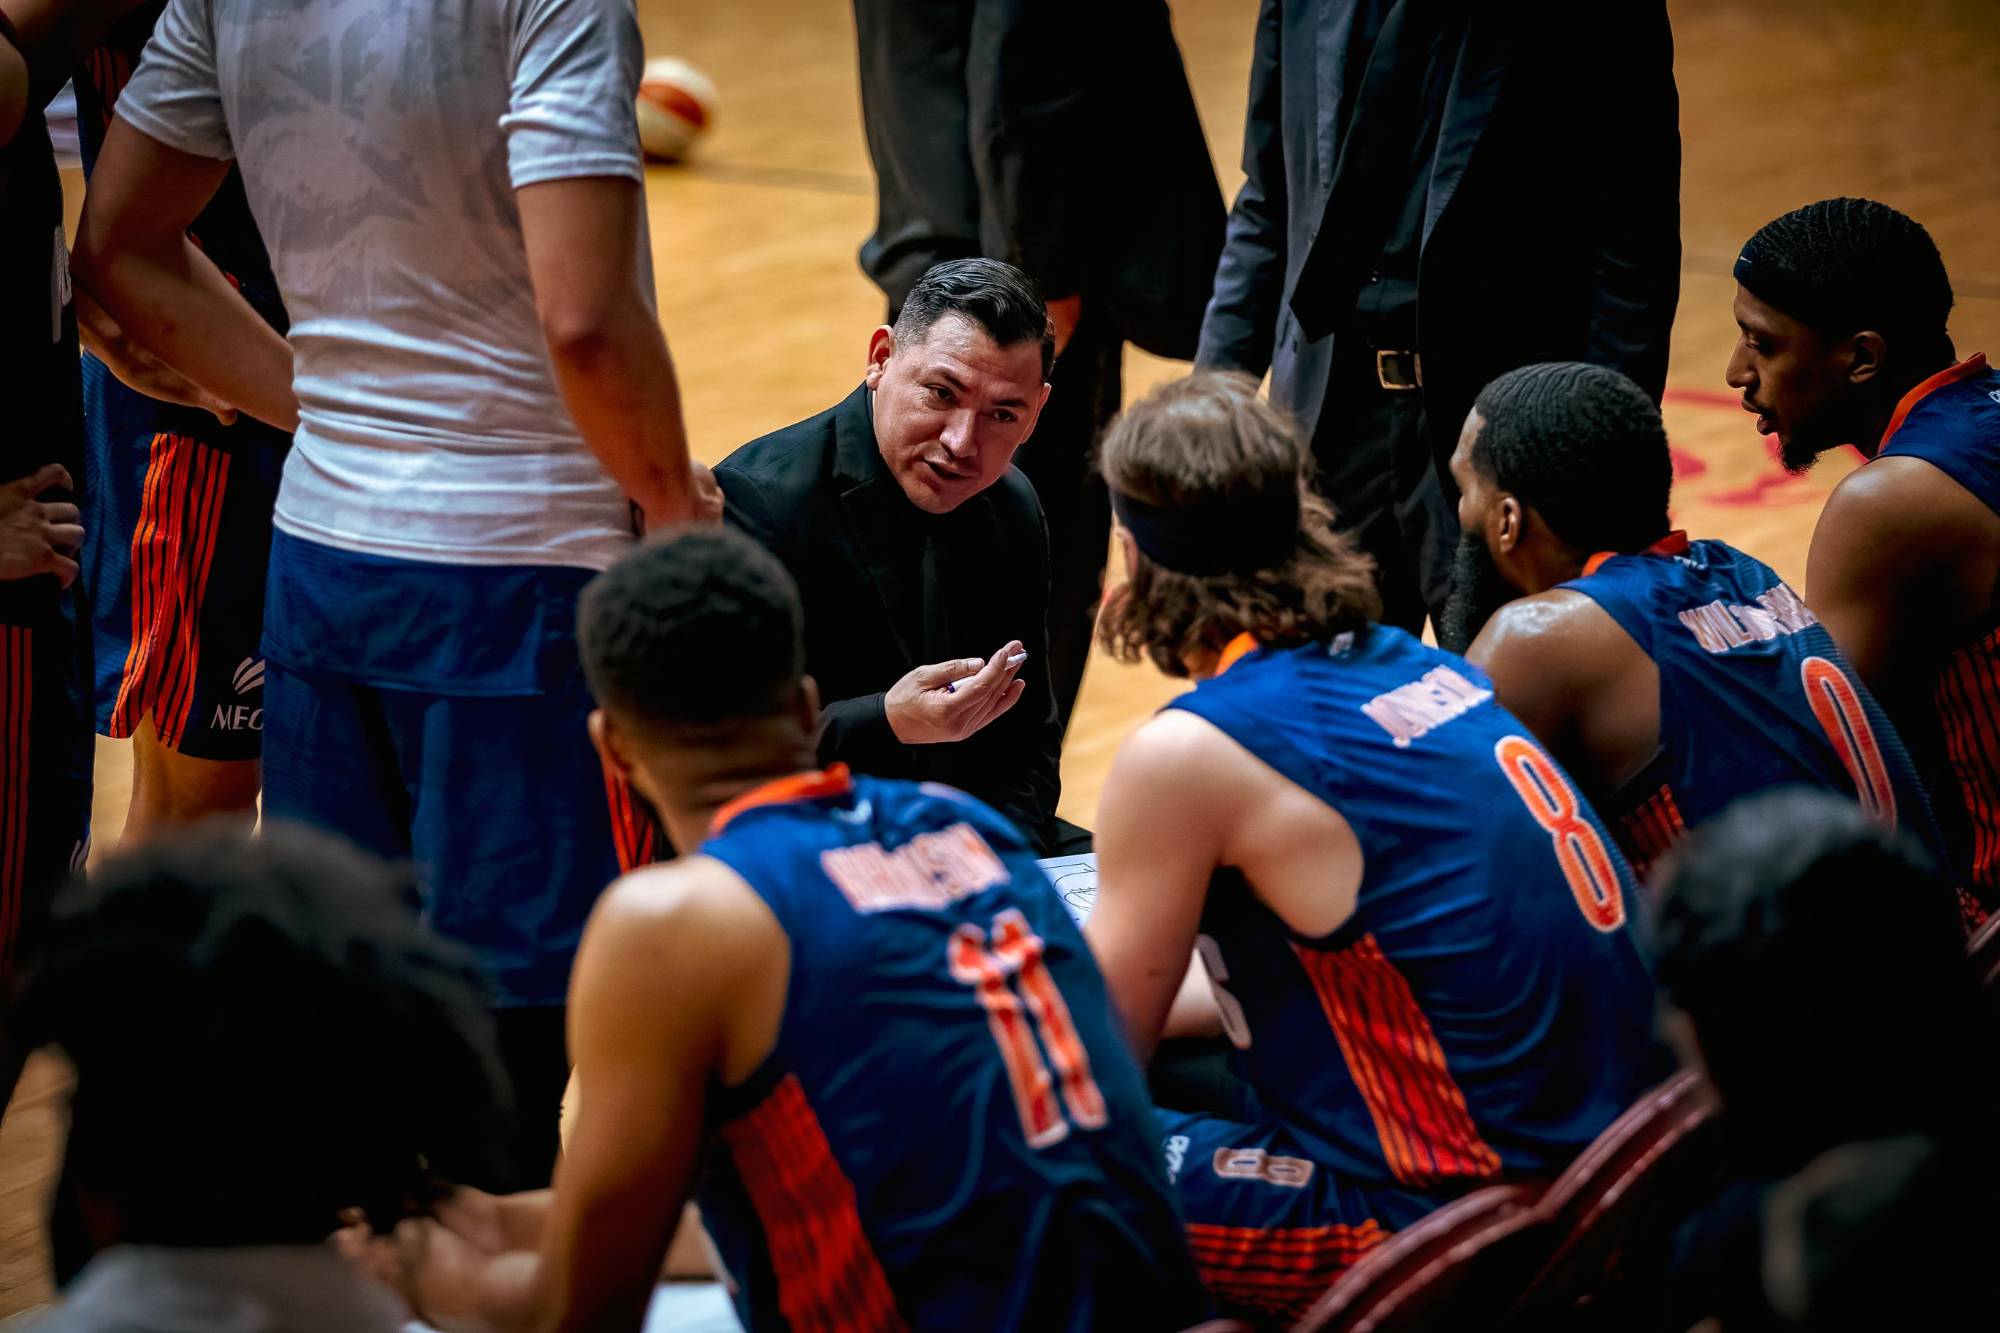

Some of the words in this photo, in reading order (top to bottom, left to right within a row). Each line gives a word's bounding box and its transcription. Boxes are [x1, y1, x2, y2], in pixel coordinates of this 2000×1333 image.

[1494, 735, 1626, 933] 8
[1801, 656, 1897, 834] 0
[947, 908, 1108, 1148] 11
